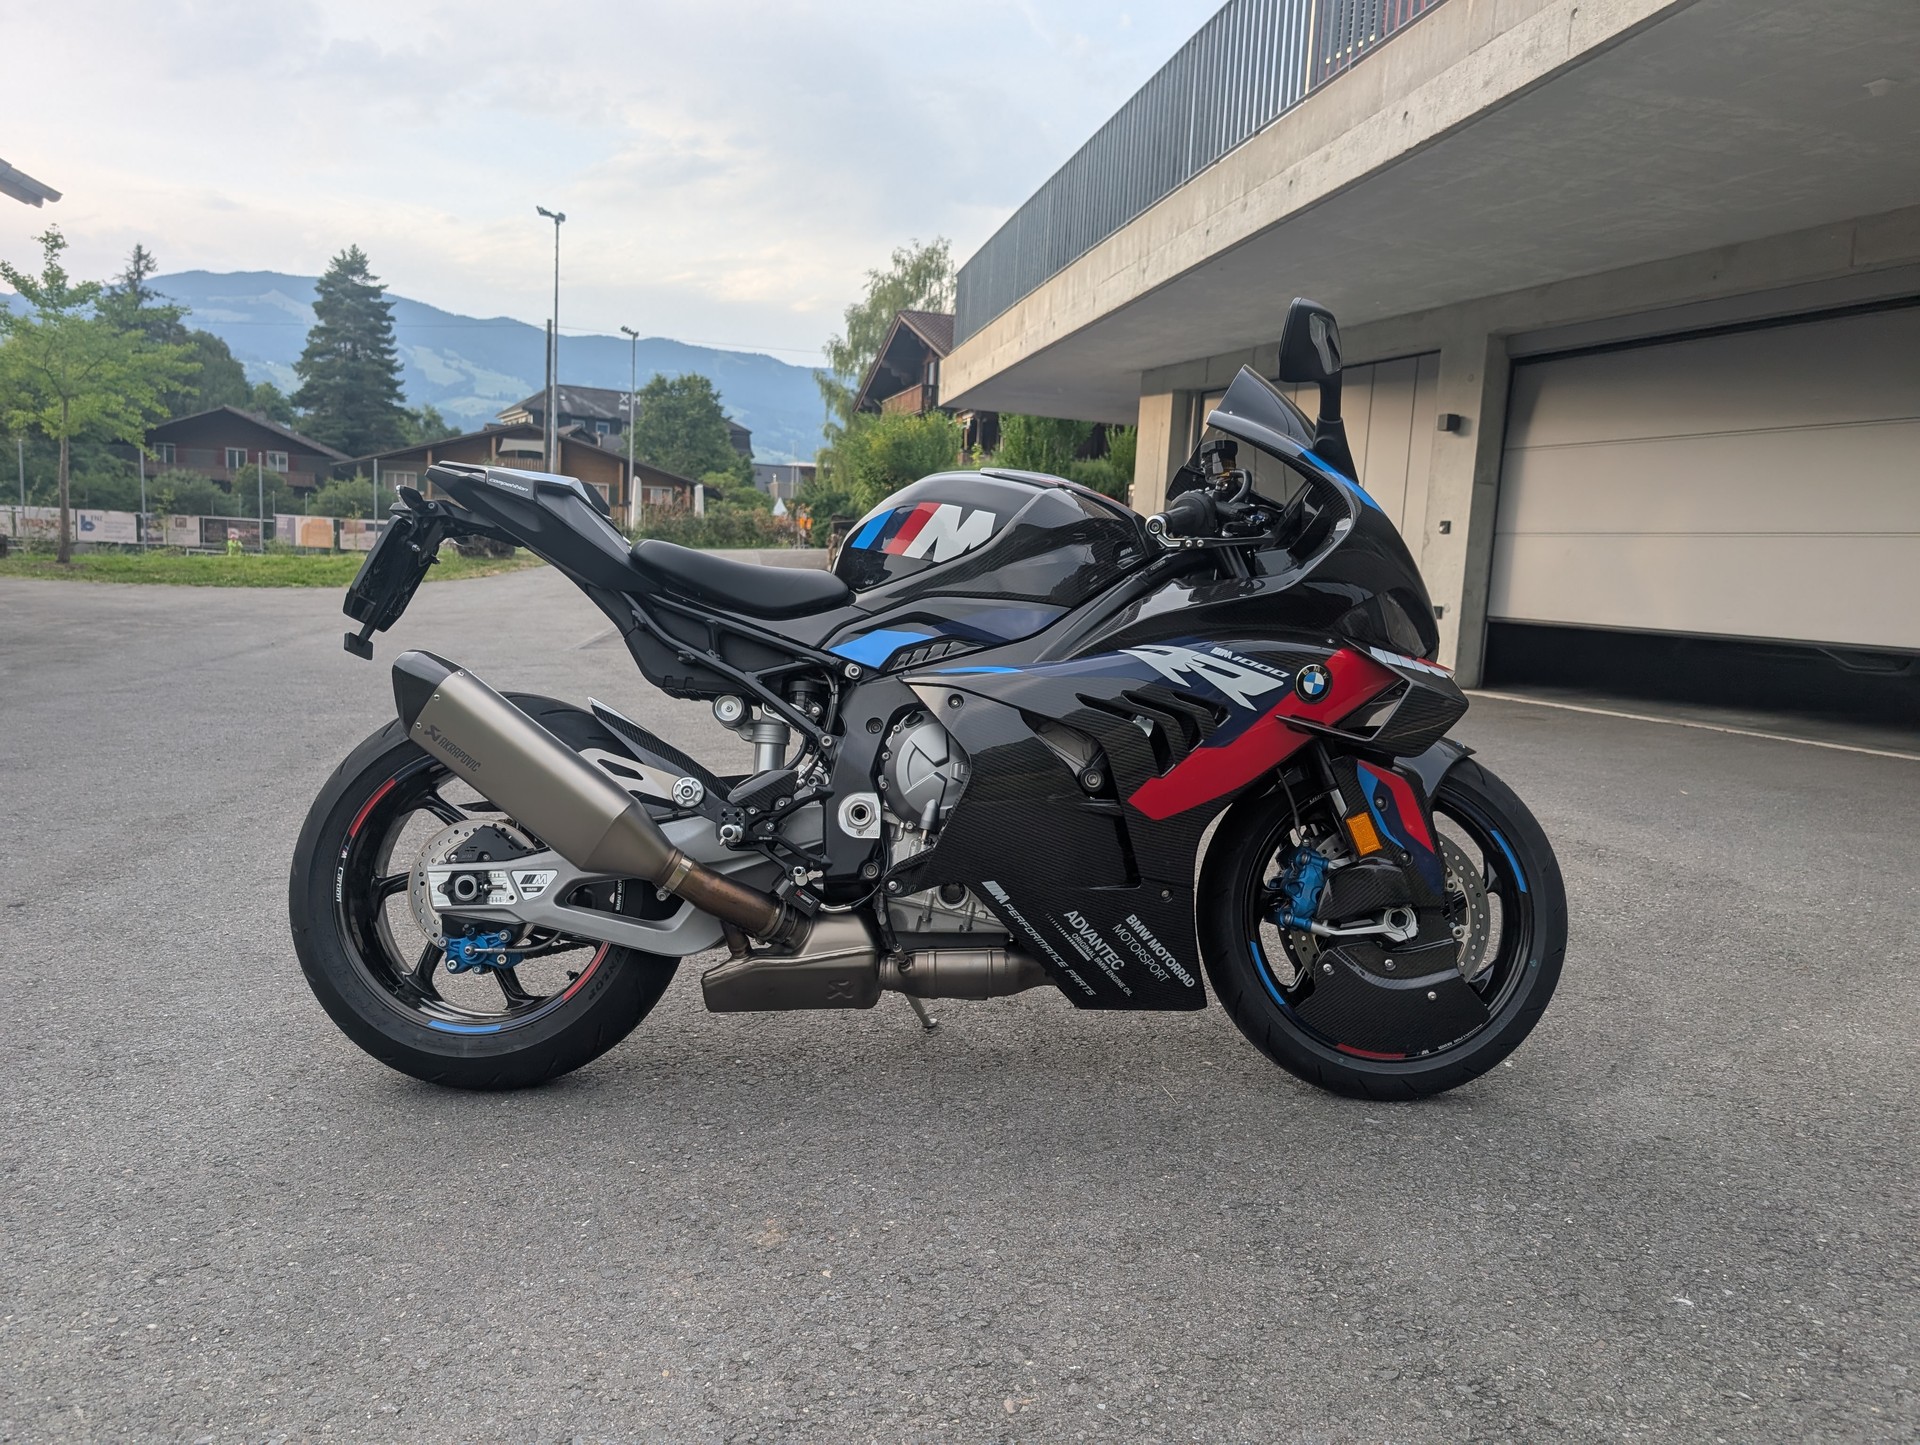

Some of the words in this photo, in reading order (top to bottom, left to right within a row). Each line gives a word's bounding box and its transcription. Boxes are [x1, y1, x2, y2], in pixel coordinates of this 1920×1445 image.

[489, 478, 529, 491] competition
[902, 503, 996, 563] M
[1231, 656, 1290, 678] 1000
[335, 866, 344, 903] Carbon
[1002, 903, 1069, 968] PERFORMANCE
[1065, 969, 1097, 996] PARTS
[1063, 910, 1125, 970] ADVANTEC
[1071, 933, 1096, 959] ORIGINAL
[1093, 957, 1109, 971] BMW
[1105, 969, 1126, 989] ENGINE
[1122, 986, 1133, 997] OIL
[1112, 923, 1171, 982] MOTORSPORT
[1125, 913, 1154, 941] BMW
[1147, 938, 1195, 988] MOTORRAD
